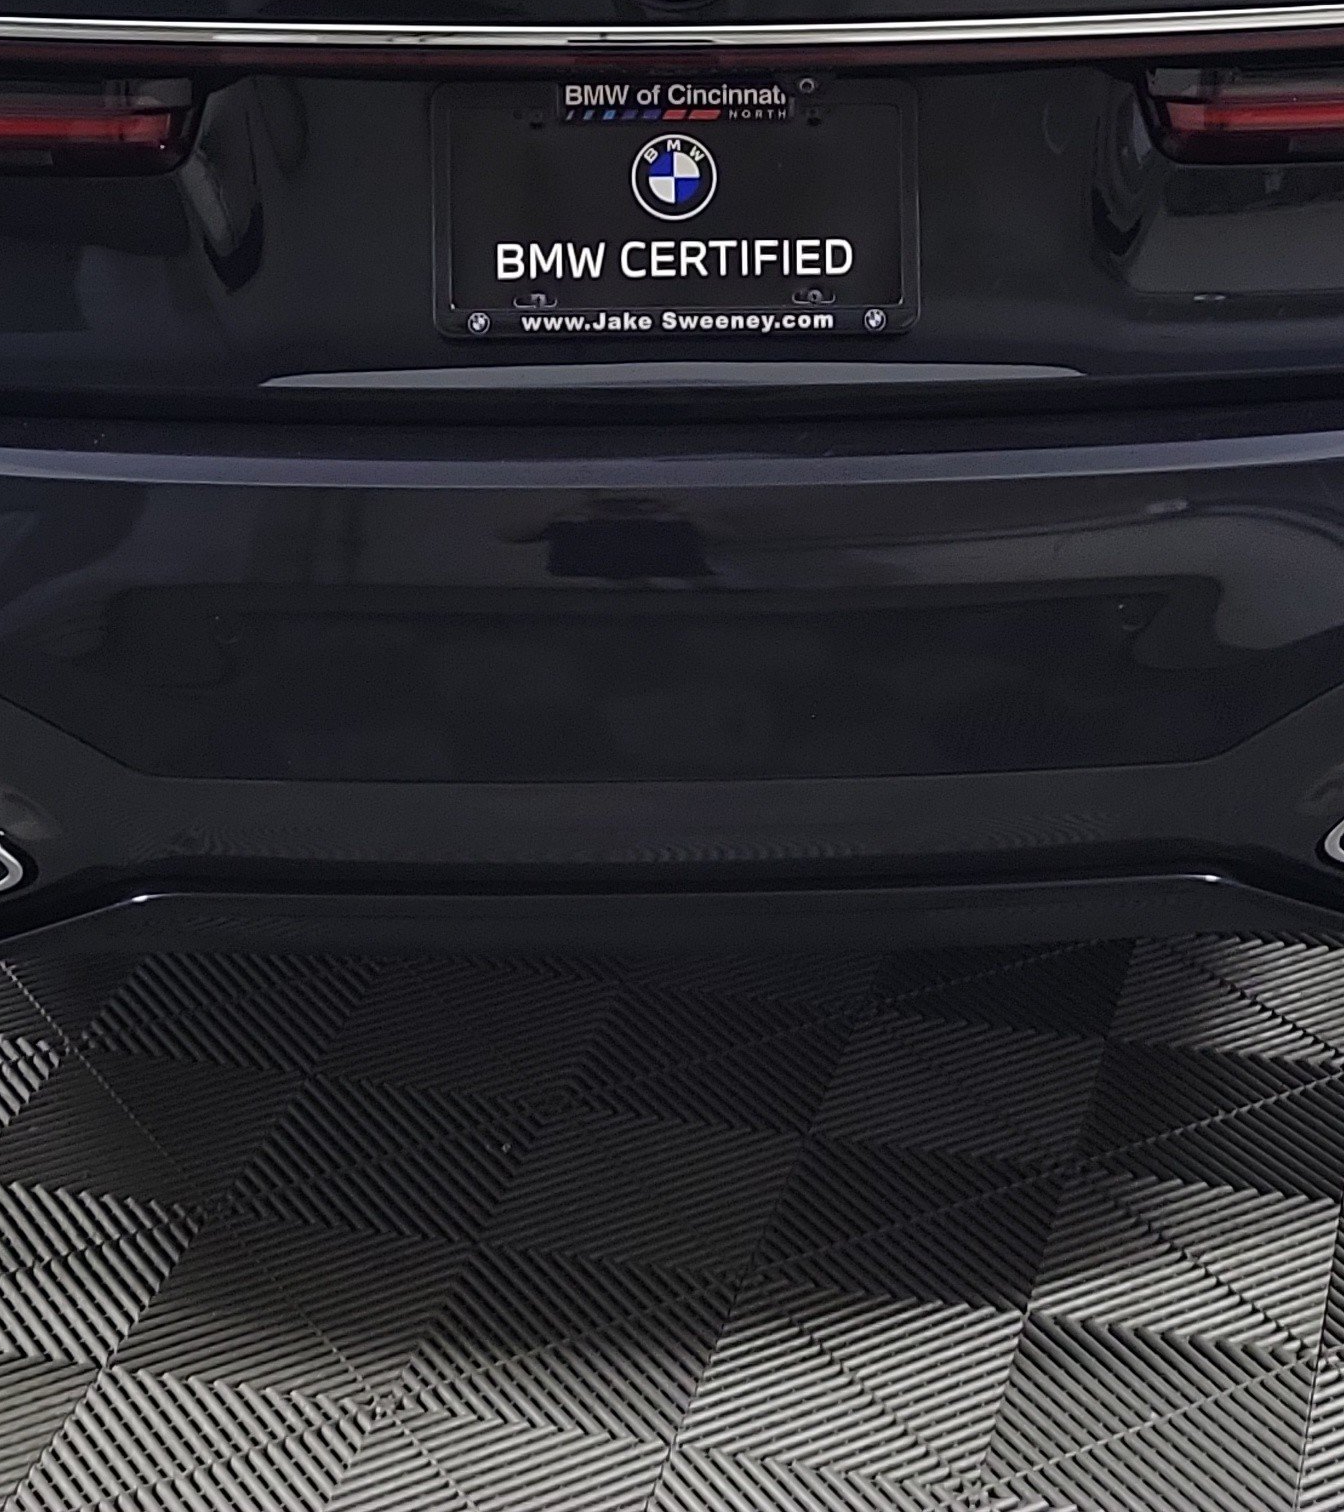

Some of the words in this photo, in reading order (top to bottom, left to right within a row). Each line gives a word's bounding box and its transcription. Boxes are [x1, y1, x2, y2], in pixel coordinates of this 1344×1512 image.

[565, 84, 630, 106] BMW
[636, 84, 661, 106] of
[728, 109, 787, 120] NORTH
[643, 139, 706, 165] BMW
[496, 241, 605, 281] BMW
[620, 238, 854, 278] CERTIFIED
[521, 311, 653, 332] www.Jake
[661, 310, 834, 333] Sweeney.com
